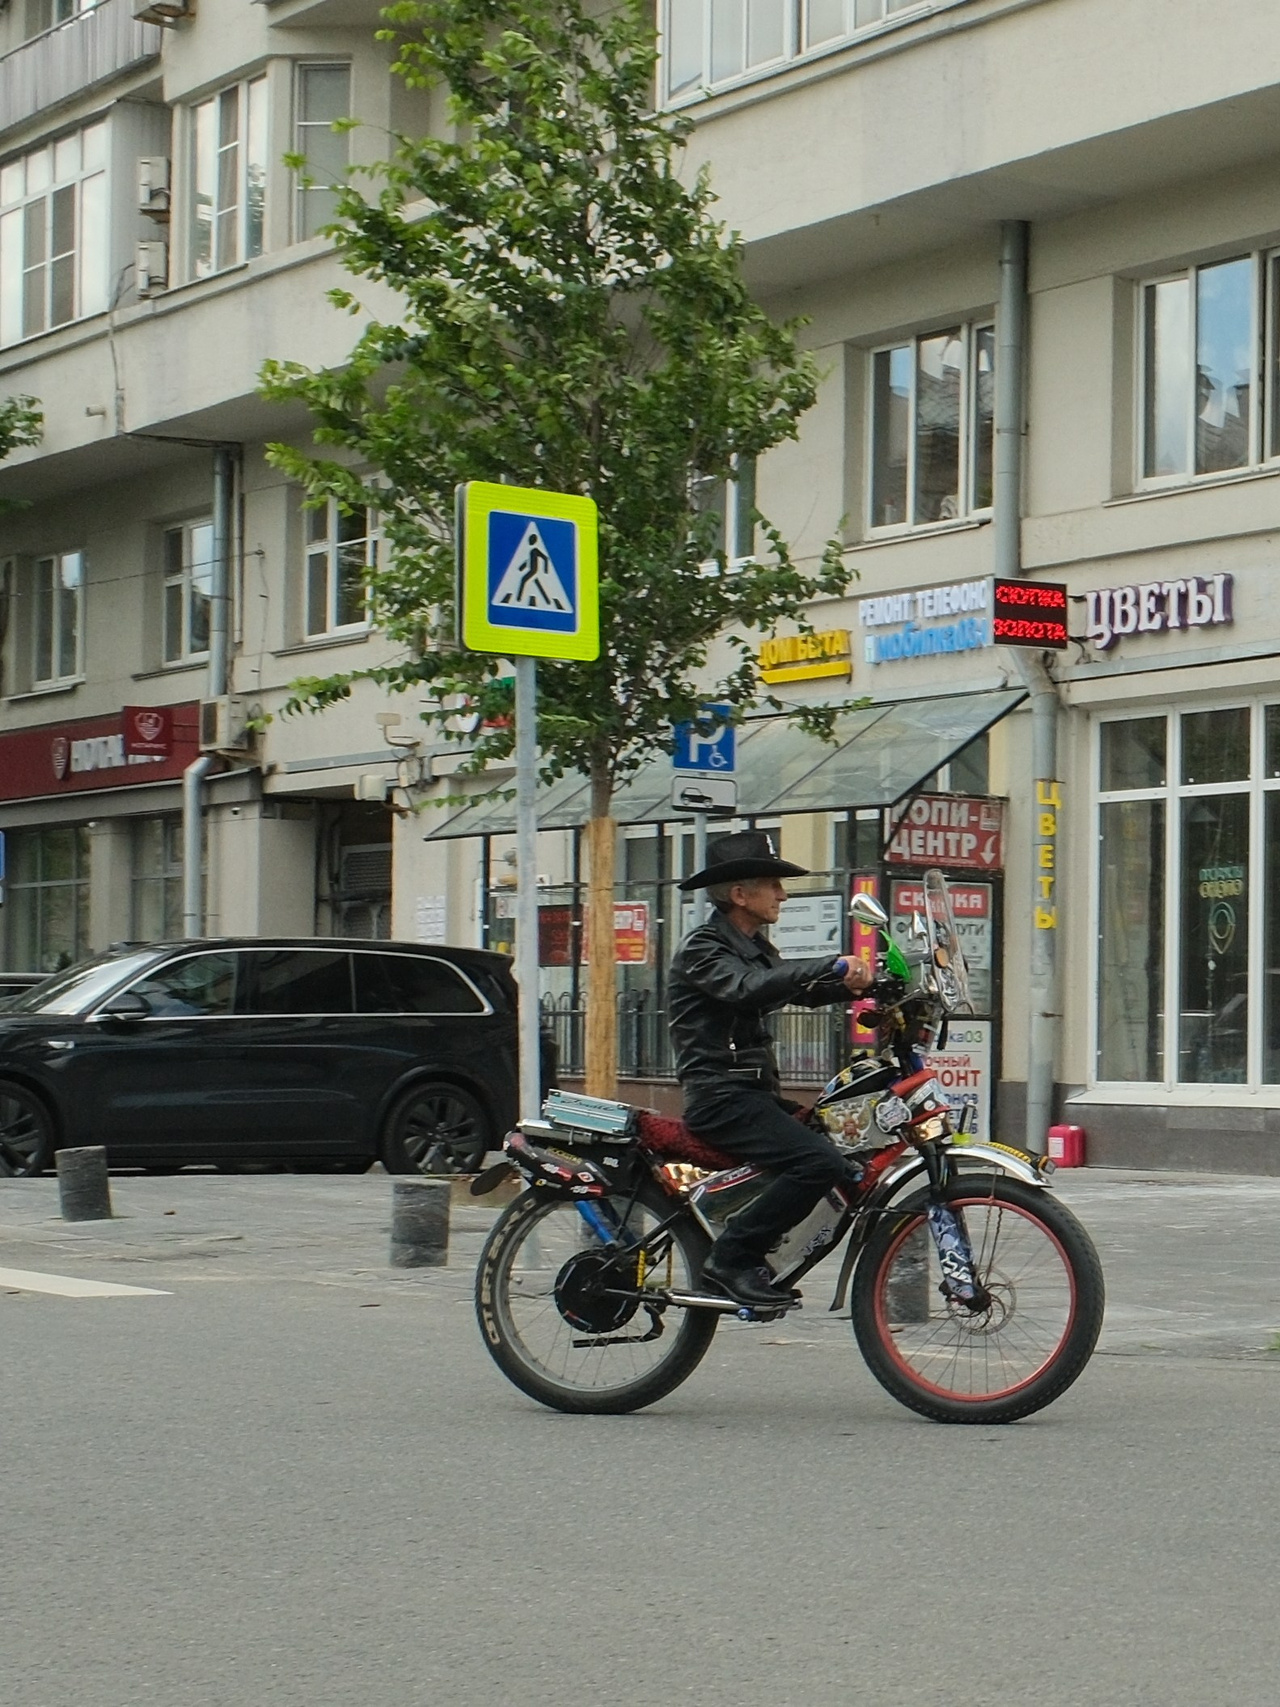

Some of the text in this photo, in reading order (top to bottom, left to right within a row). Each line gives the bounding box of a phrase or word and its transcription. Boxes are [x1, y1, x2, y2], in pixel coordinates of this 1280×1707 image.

[859, 580, 987, 626] РЕМОНТ ТЕЛЕФОНО
[1086, 573, 1231, 649] ЦВЕТЫ
[758, 636, 793, 671] ДОМ
[891, 798, 979, 828] КОПИ-
[889, 828, 978, 860] ЦЕНТР
[1035, 780, 1062, 930] ЦВЕТЫ
[899, 890, 982, 908] СККА
[923, 1054, 971, 1068] ОЧНЫЙ
[935, 1070, 981, 1087] ОНТ
